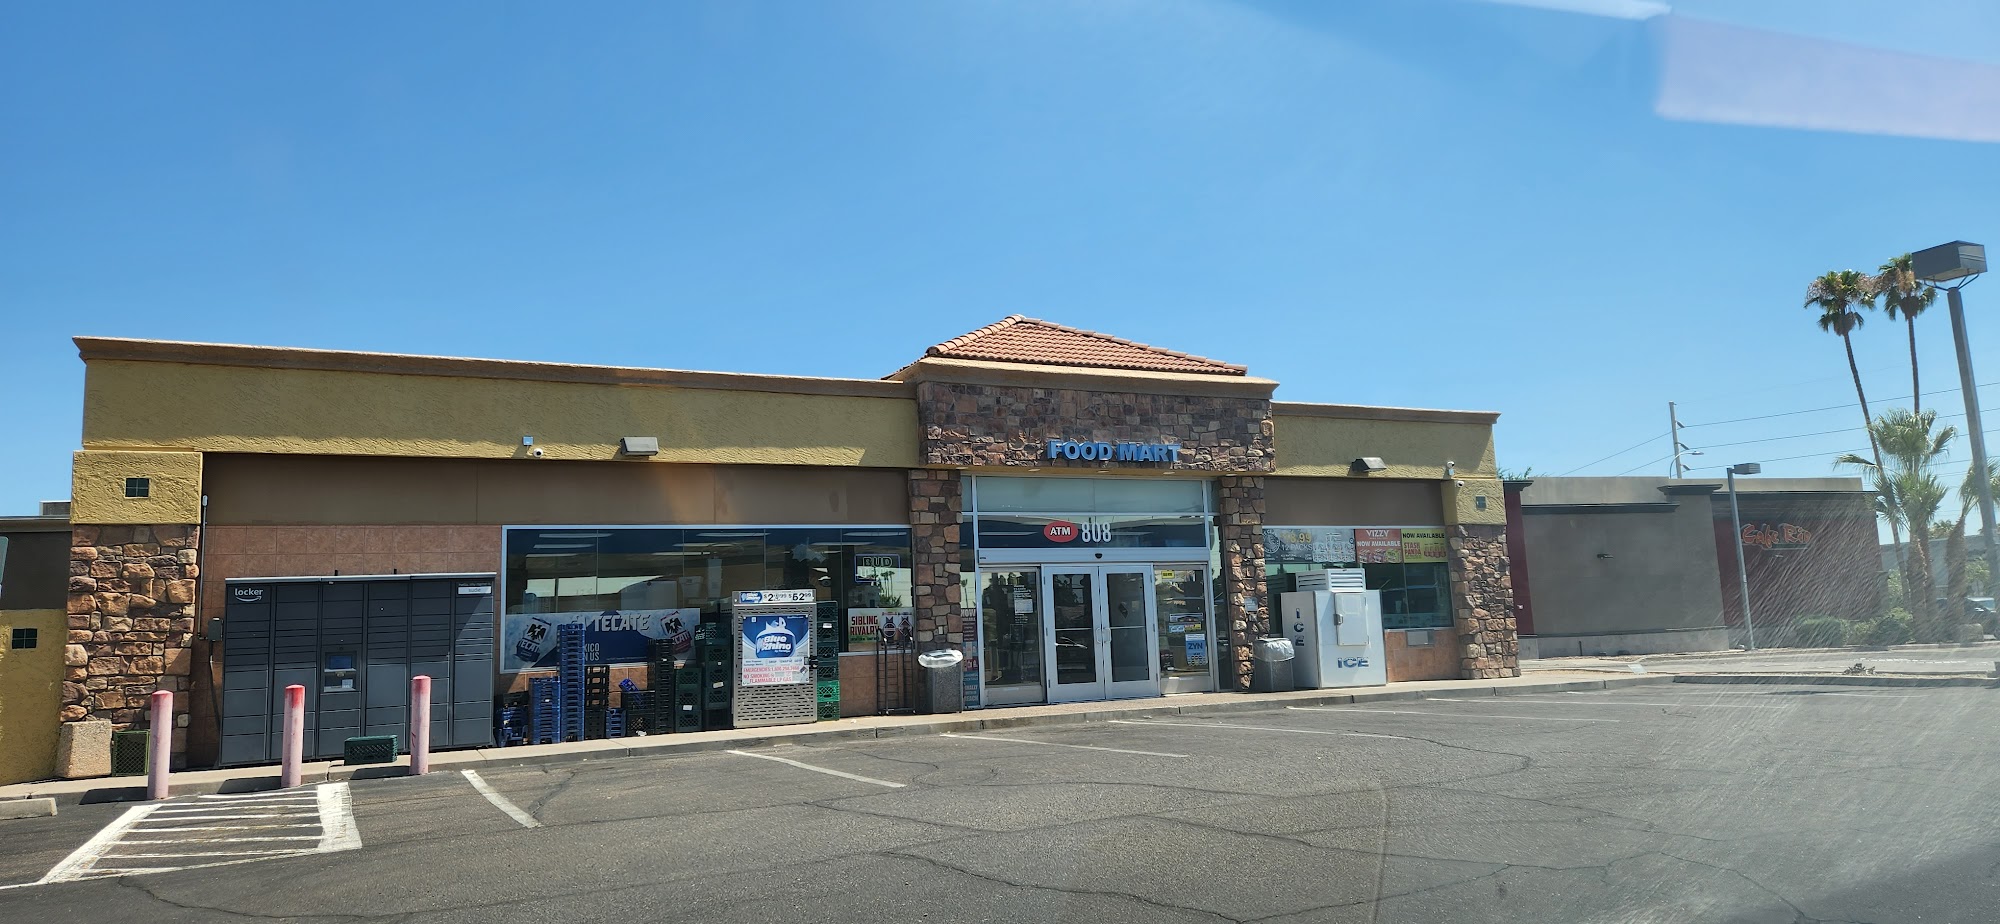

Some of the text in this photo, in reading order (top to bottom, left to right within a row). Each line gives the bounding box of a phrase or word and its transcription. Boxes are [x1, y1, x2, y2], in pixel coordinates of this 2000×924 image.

[1048, 440, 1181, 462] FOOD MART
[1050, 521, 1112, 543] ATM 808
[1366, 529, 1390, 538] VIZZY
[1780, 524, 1811, 543] Rio
[1290, 543, 1313, 551] PACKS
[862, 556, 893, 568] BUD
[234, 587, 264, 596] locker
[593, 613, 651, 632] TECATE
[851, 615, 878, 626] SIBLING
[1293, 607, 1305, 647] ICE
[764, 635, 787, 643] Blue
[1188, 642, 1203, 650] ZYN
[1337, 656, 1369, 669] ICE
